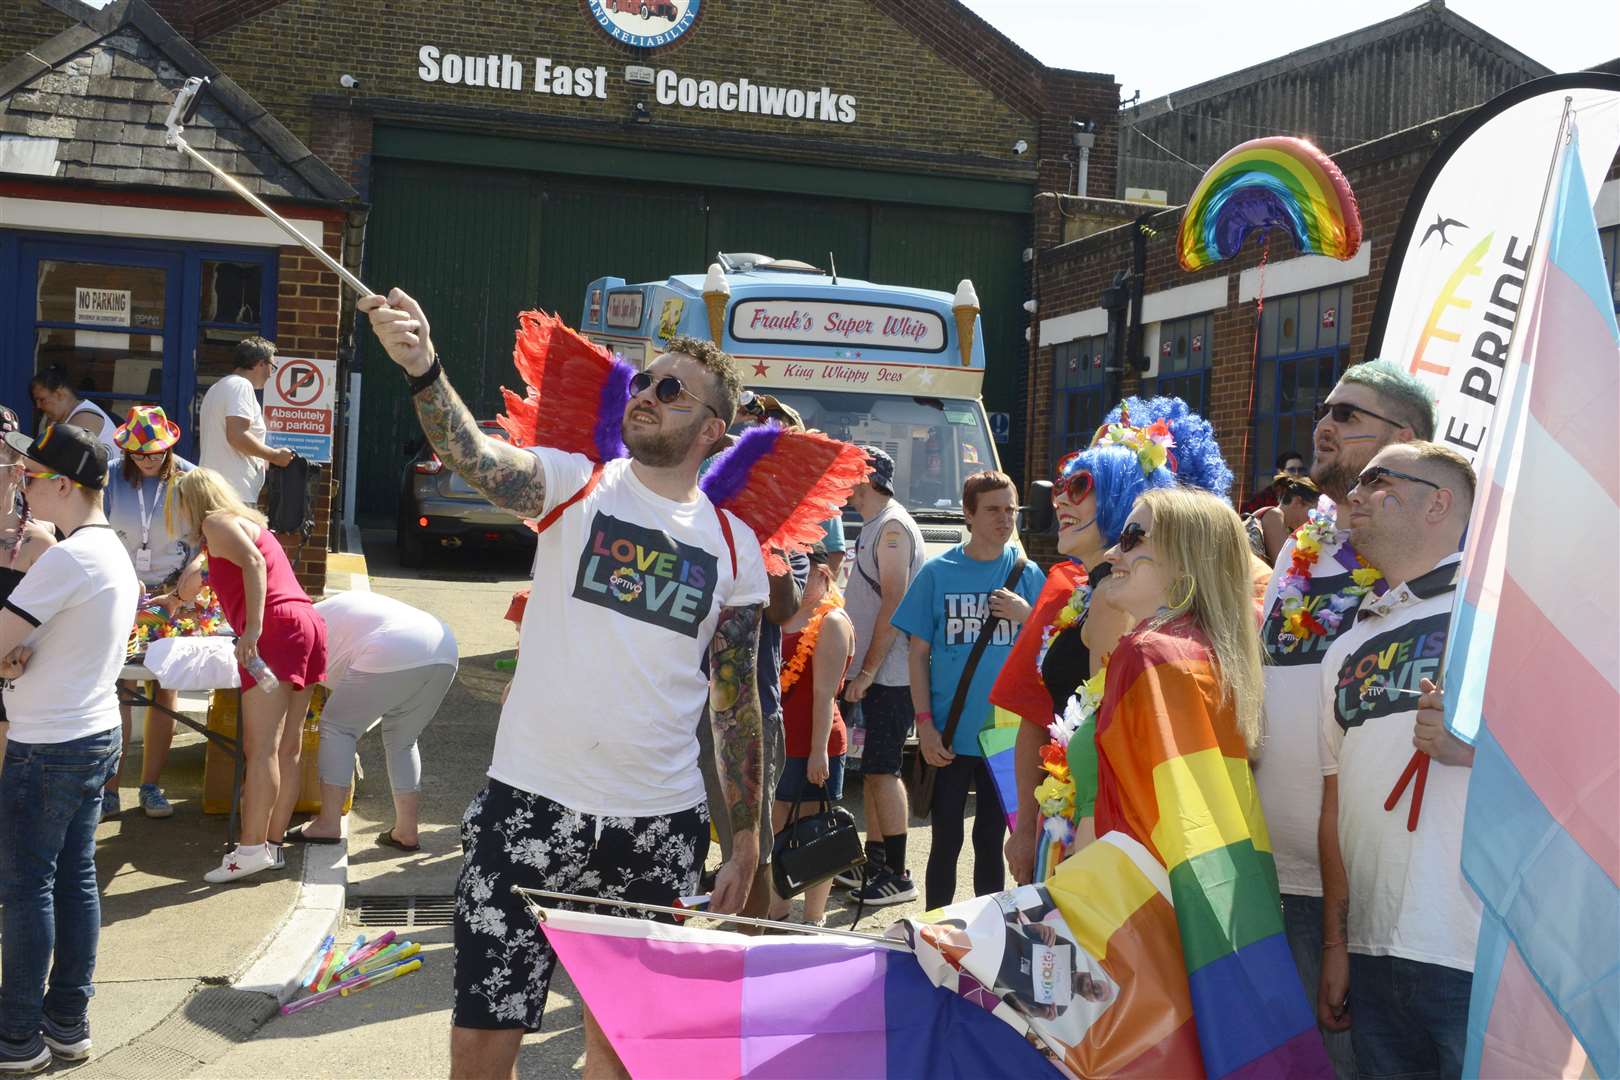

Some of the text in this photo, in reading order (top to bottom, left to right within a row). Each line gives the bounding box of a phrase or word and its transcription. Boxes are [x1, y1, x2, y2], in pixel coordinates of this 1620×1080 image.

[612, 9, 696, 47] RELIABILITY
[418, 45, 857, 123] South East Coachworks
[79, 291, 126, 312] NO PARKING
[750, 308, 929, 344] Frank's Super Whip
[1459, 235, 1533, 406] PRIDE
[783, 363, 903, 384] King Whippy Ices
[270, 420, 325, 432] no parking
[271, 408, 325, 422] Absolutely
[592, 531, 706, 588] LOVE IS
[583, 555, 703, 624] LOVE
[610, 574, 642, 593] OPTIVO
[944, 593, 992, 620] TRA
[1414, 631, 1446, 657] IS
